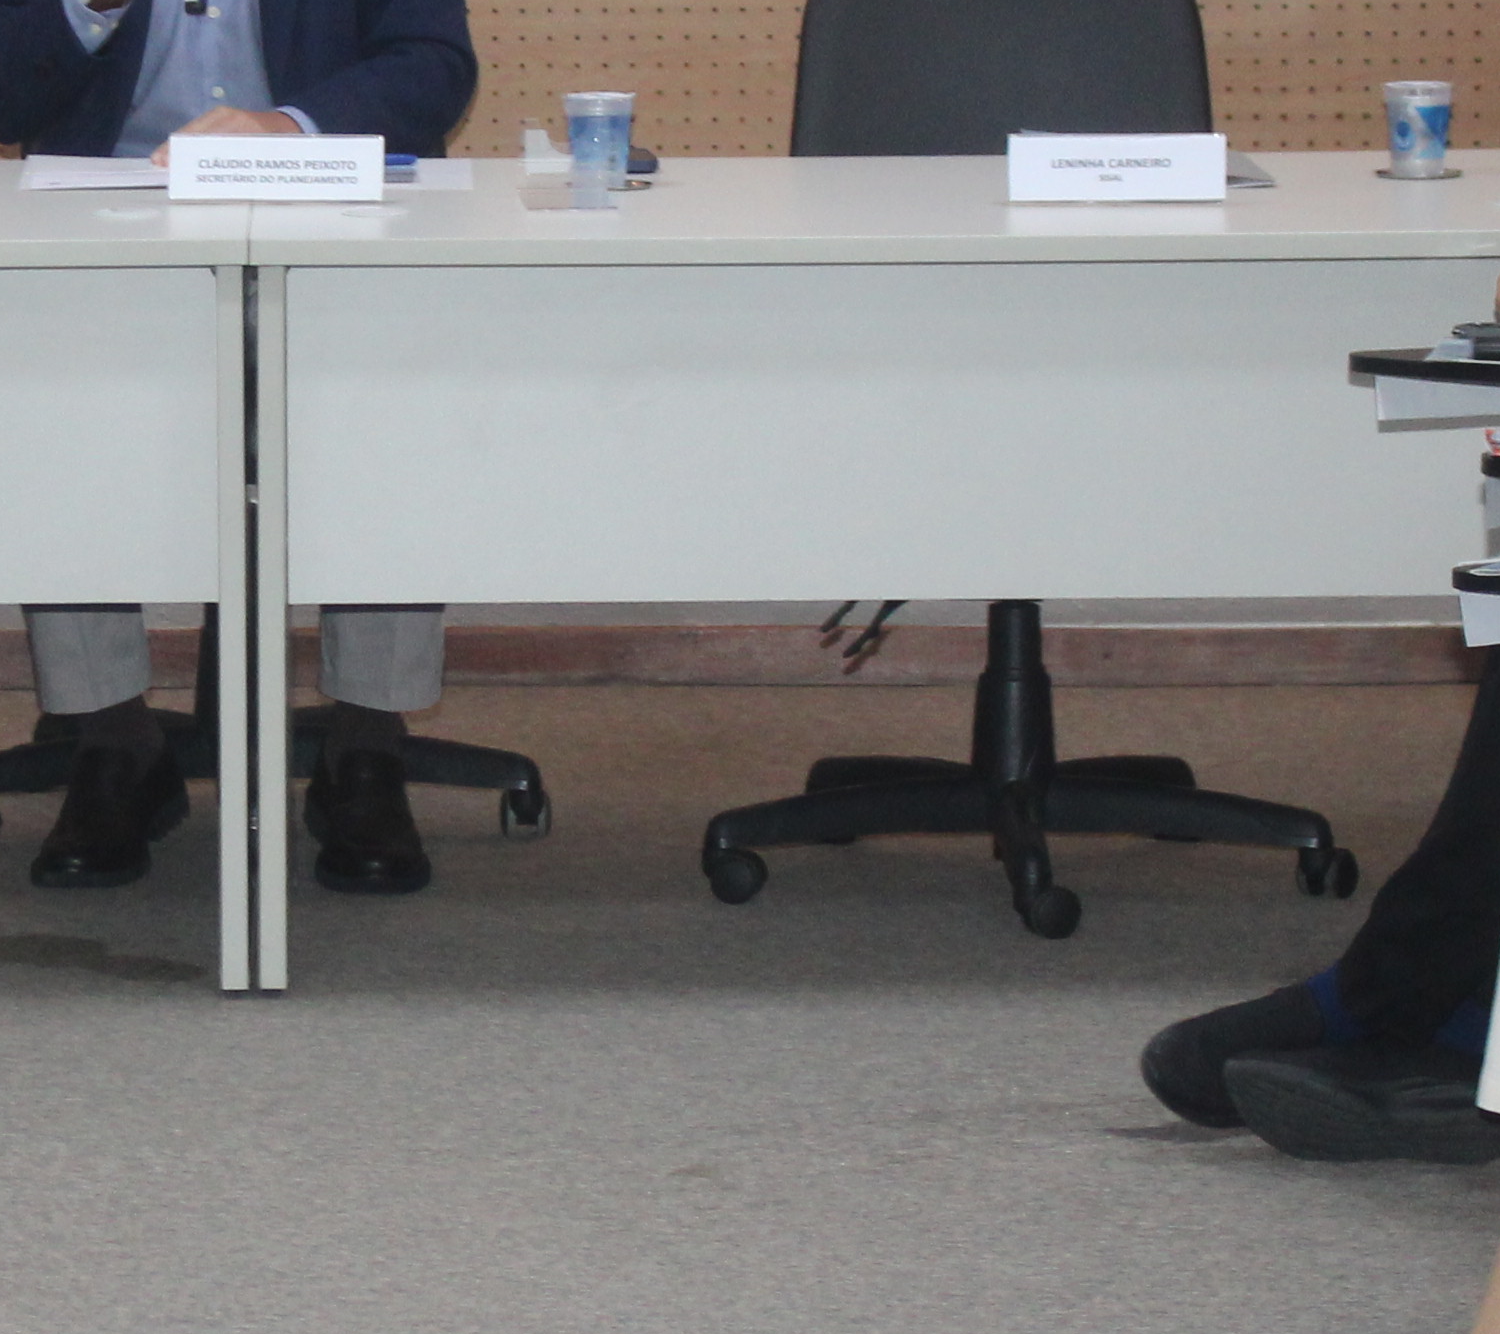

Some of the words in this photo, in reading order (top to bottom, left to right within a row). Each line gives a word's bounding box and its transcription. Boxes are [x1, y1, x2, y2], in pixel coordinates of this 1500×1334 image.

[198, 158, 252, 170] CLÁUDIO
[256, 160, 301, 170] RAMOS
[304, 160, 357, 170] PEIXOTO
[1051, 159, 1105, 169] LENINHA
[1108, 158, 1171, 169] CARNEIRO
[195, 173, 257, 184] SECRETÁRIO
[259, 175, 275, 183] DO
[277, 175, 358, 184] PLANEJAMENTO
